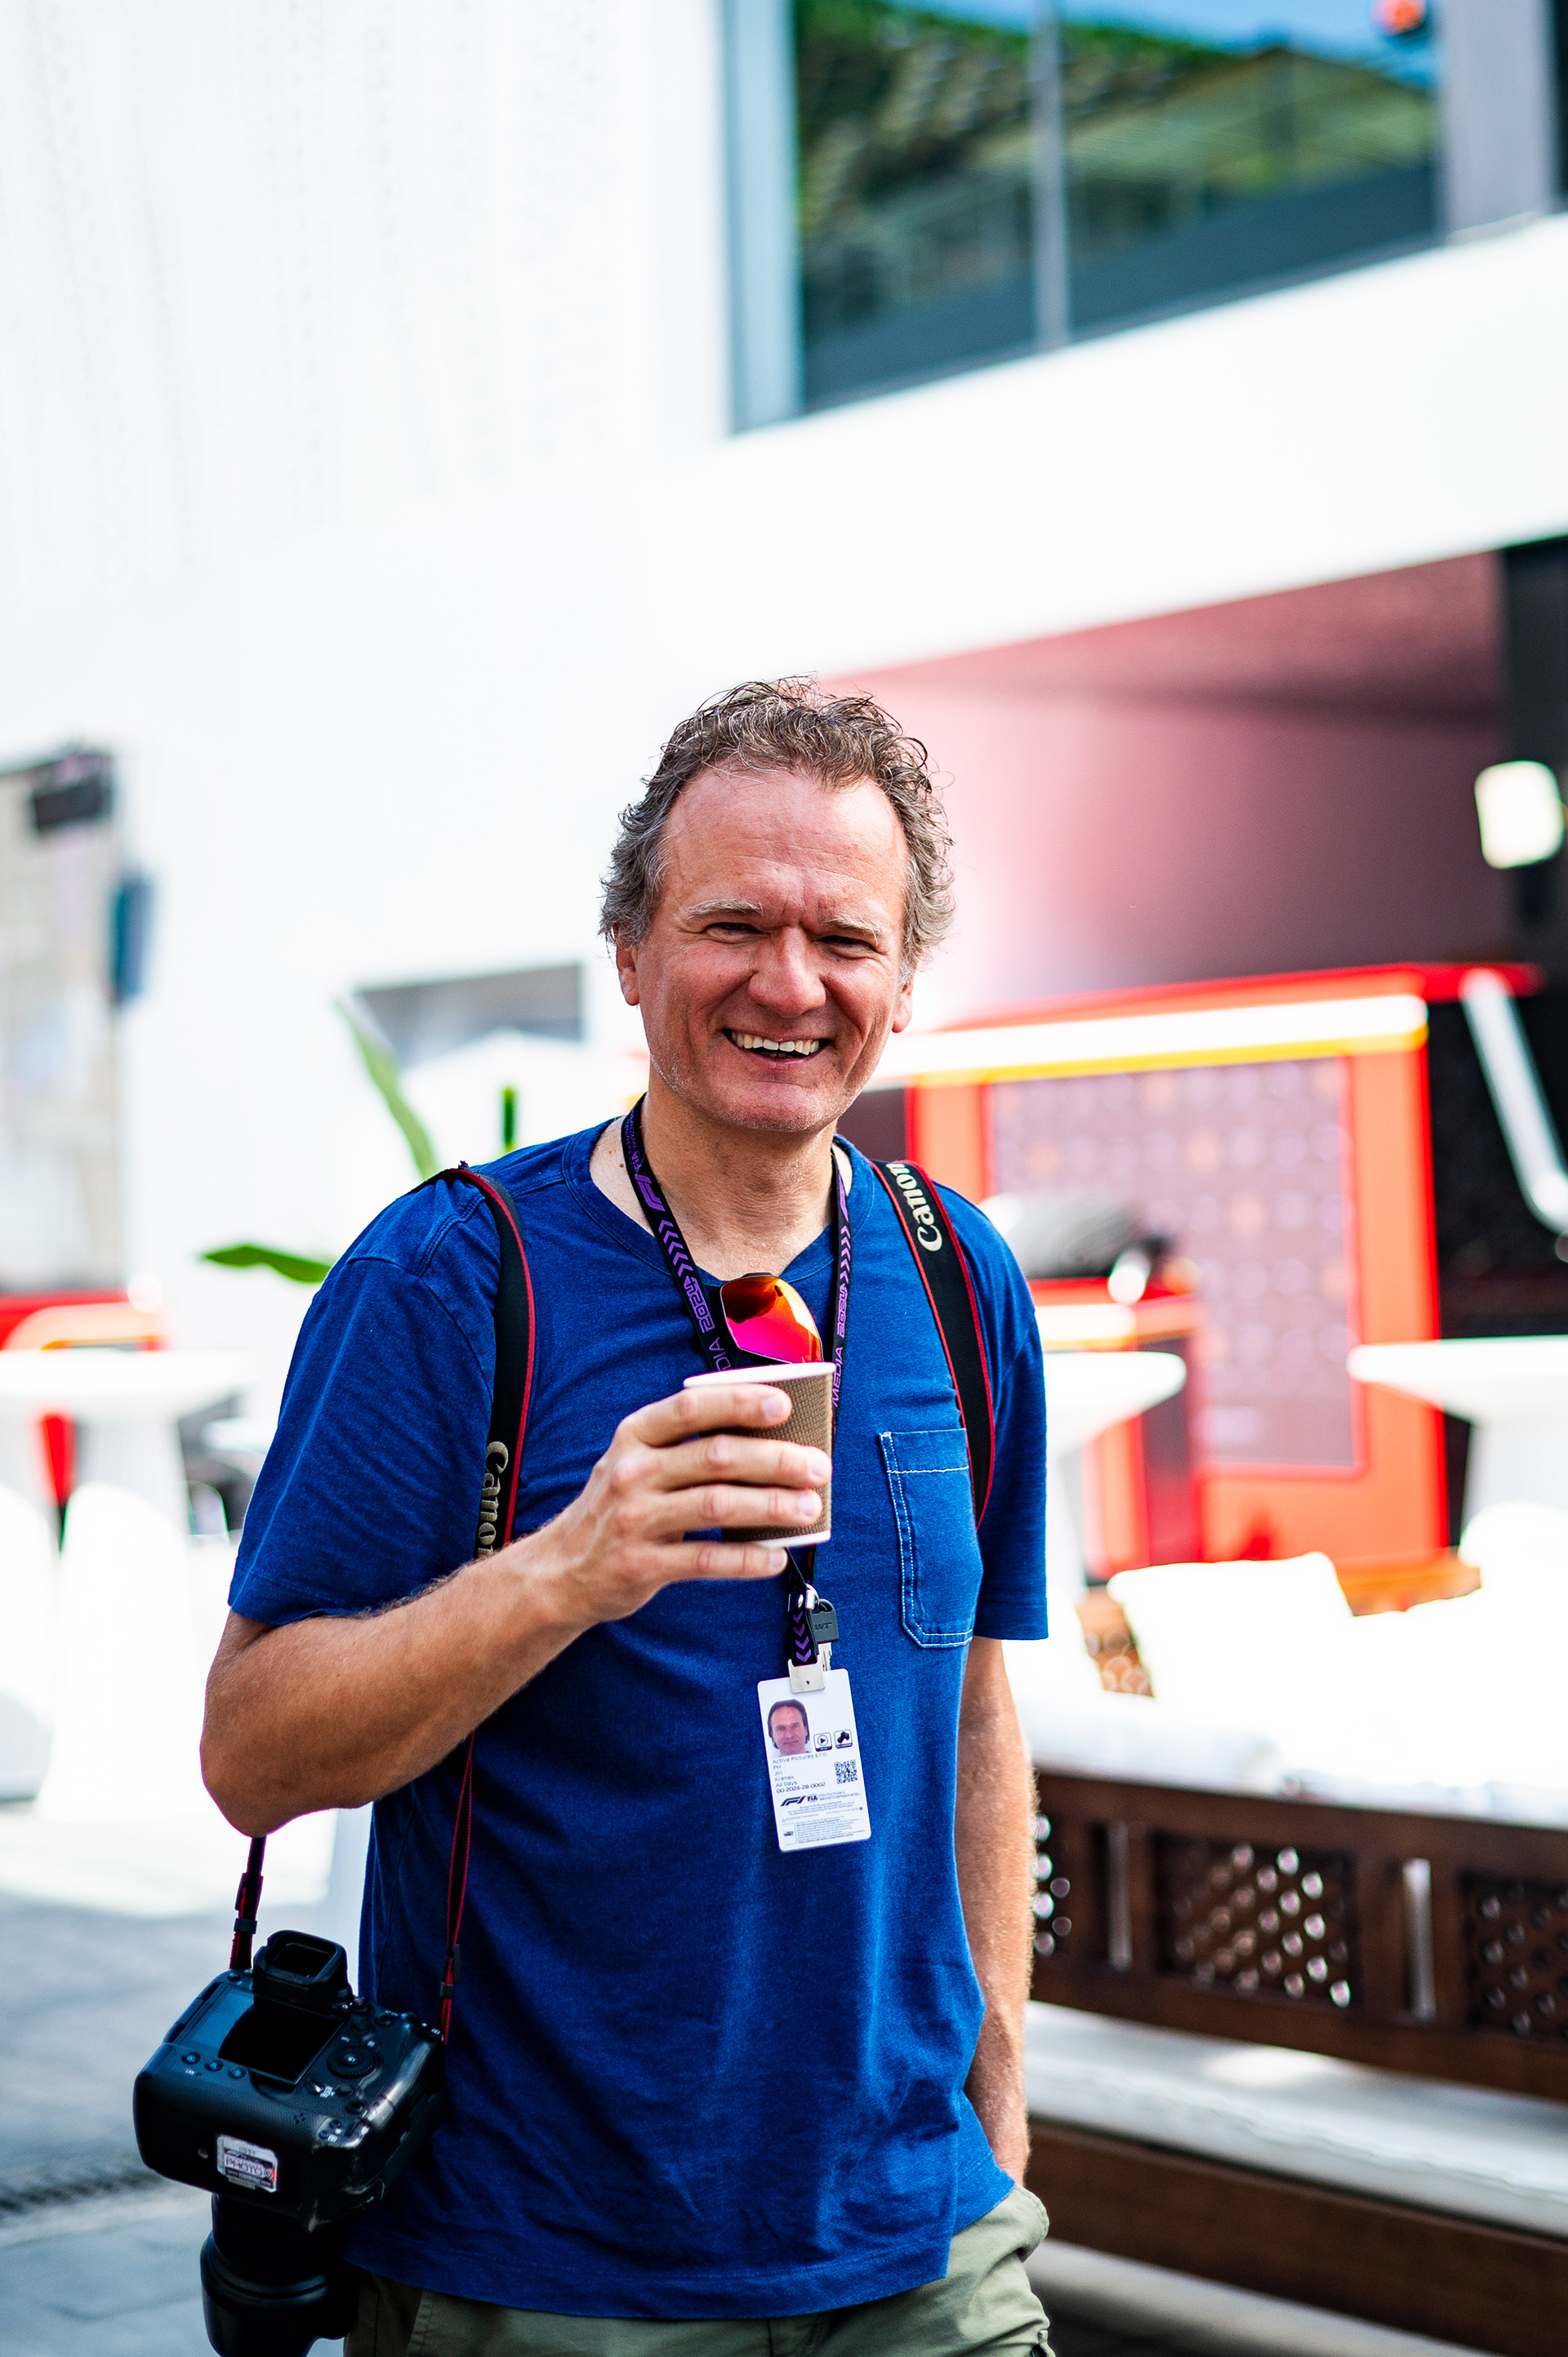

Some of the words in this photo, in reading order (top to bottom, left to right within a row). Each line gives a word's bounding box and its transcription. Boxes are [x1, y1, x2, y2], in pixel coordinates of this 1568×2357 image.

[885, 1163, 942, 1251] Canon
[684, 1275, 715, 1334] 2024
[836, 1283, 848, 1339] 2024
[709, 1337, 732, 1371] DIA
[832, 1346, 844, 1408] MEDIA
